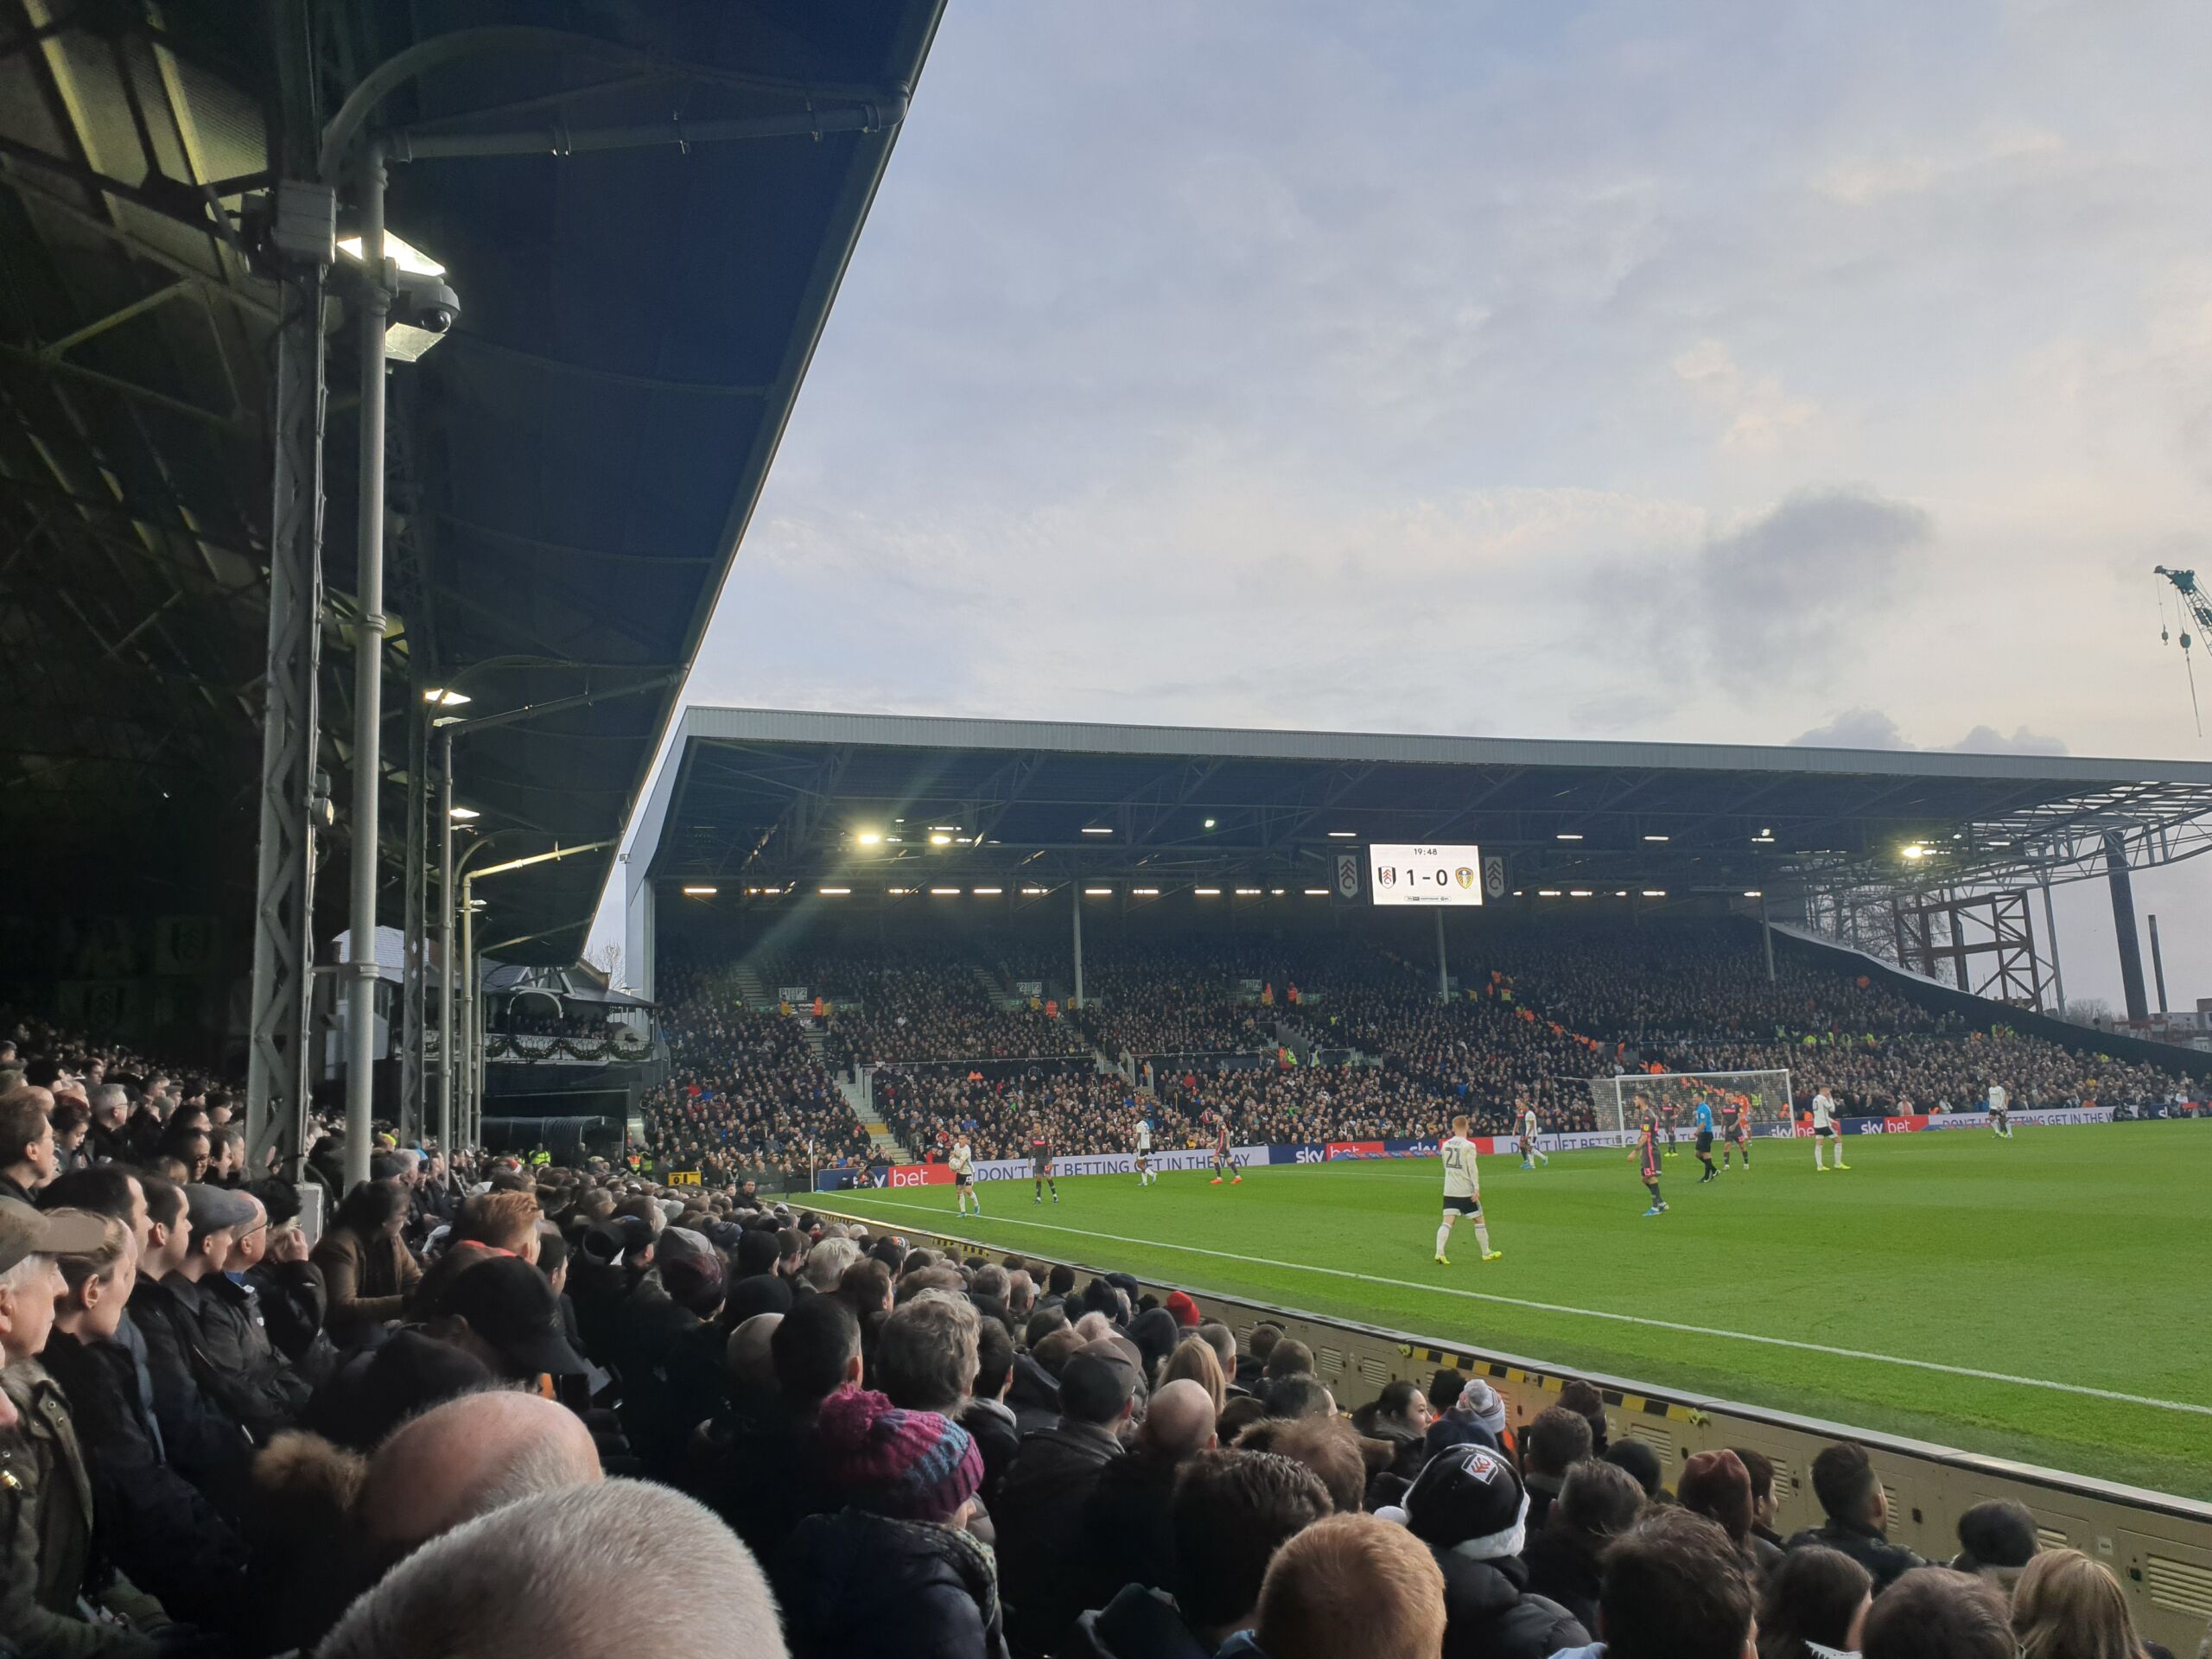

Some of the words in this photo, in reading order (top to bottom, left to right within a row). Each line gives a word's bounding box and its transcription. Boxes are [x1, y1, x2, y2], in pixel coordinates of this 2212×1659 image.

[1406, 869, 1414, 886] 1
[1436, 869, 1448, 886] 0
[1861, 1121, 1884, 1134] sky
[1887, 1119, 1911, 1134] bet
[2047, 1115, 2067, 1125] GET
[2070, 1114, 2081, 1124] IN
[2083, 1113, 2103, 1124] THE
[1796, 1124, 1815, 1137] be
[1296, 1147, 1325, 1164] sky
[1445, 1147, 1463, 1169] 21
[893, 1169, 929, 1187] bet
[977, 1166, 1027, 1181] DON'T
[1065, 1160, 1128, 1176] BETTING
[1167, 1158, 1181, 1170] IN
